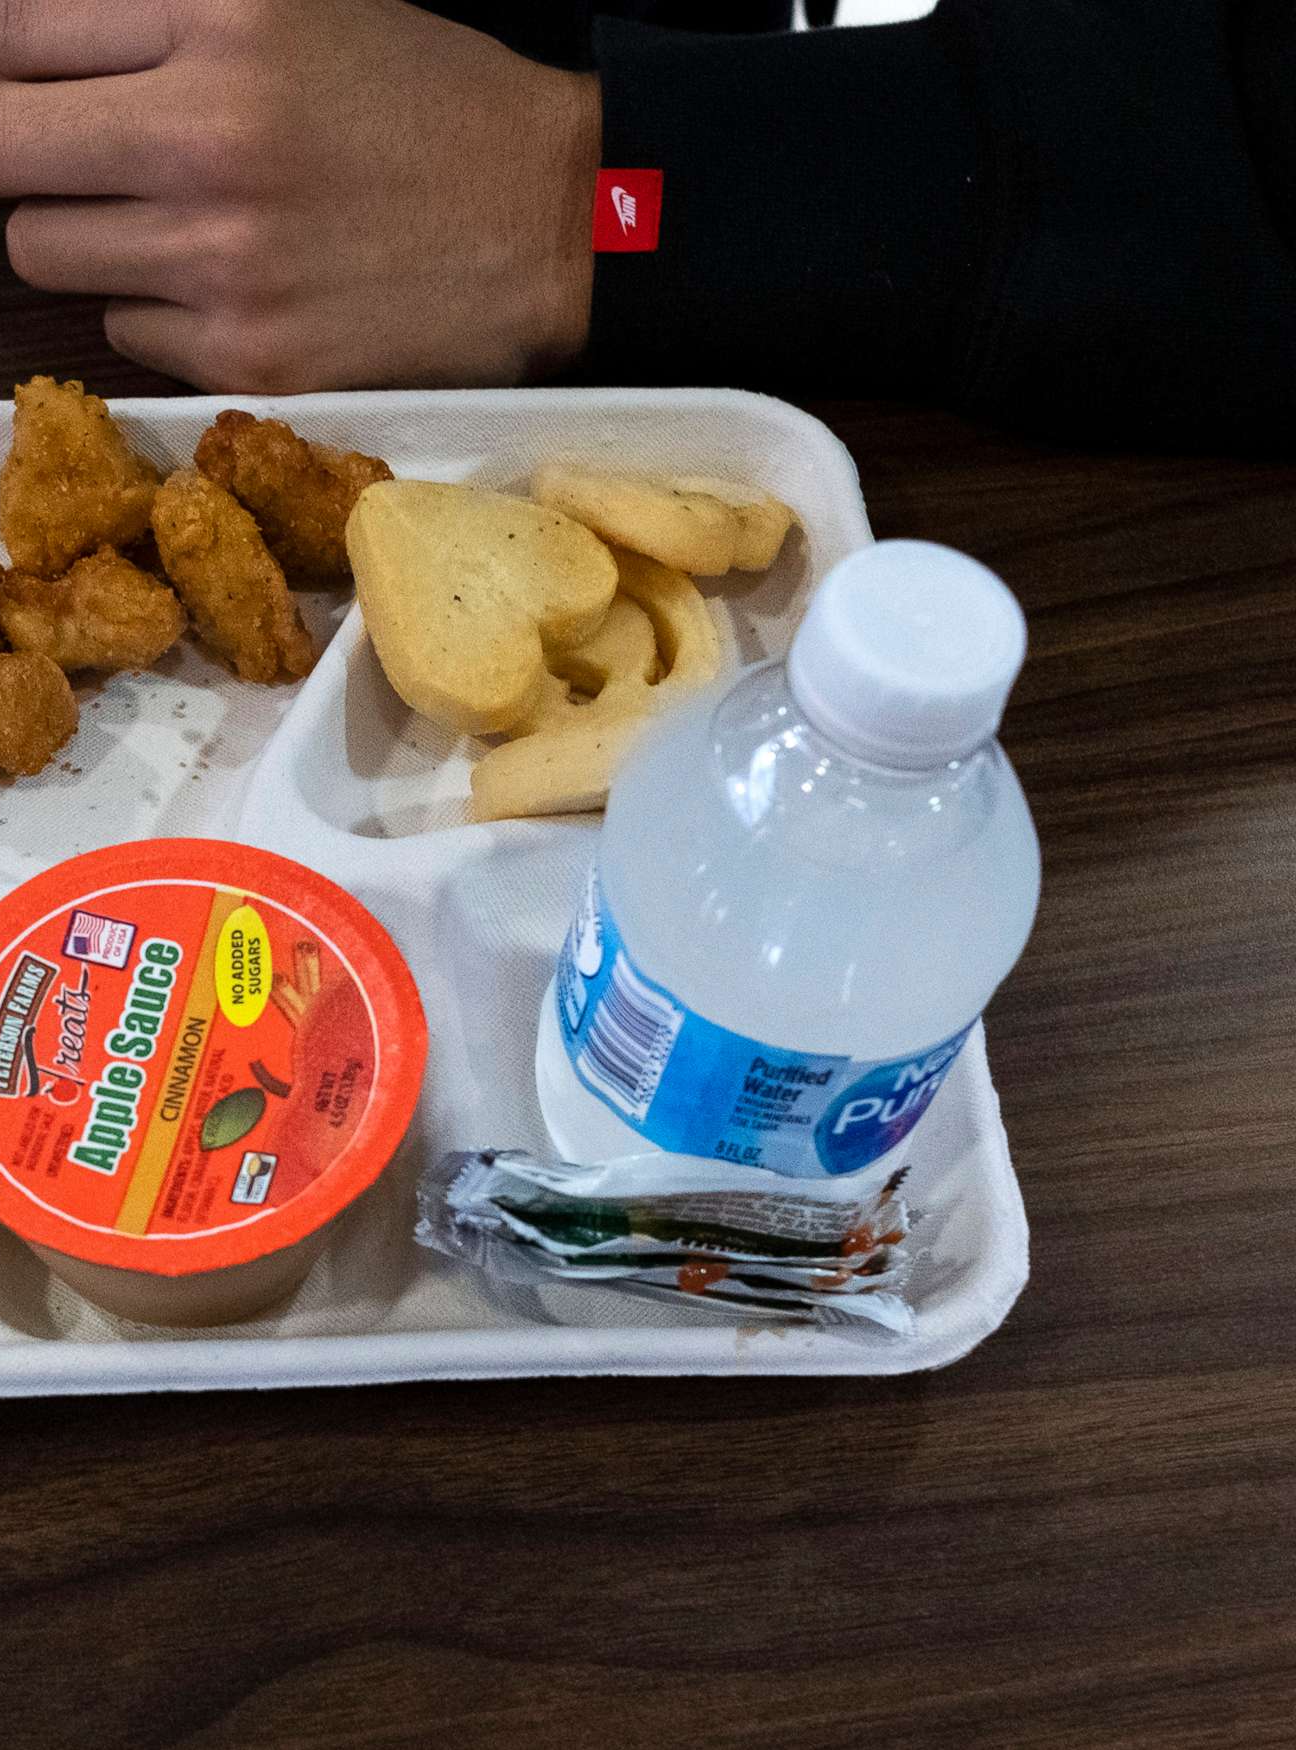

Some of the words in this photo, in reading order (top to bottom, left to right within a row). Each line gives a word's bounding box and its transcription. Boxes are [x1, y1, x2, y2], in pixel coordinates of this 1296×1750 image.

[116, 928, 128, 946] USA
[231, 929, 245, 979] ADDED
[248, 936, 262, 996] SUGARS
[6, 963, 47, 1016] FARMS
[231, 984, 245, 1006] NO
[72, 1065, 143, 1172] Apple
[109, 941, 180, 1058] Sauce
[159, 1016, 208, 1122] CINNAMON
[749, 1056, 833, 1086] Purified
[743, 1074, 803, 1103] Water
[743, 1147, 763, 1160] OZ
